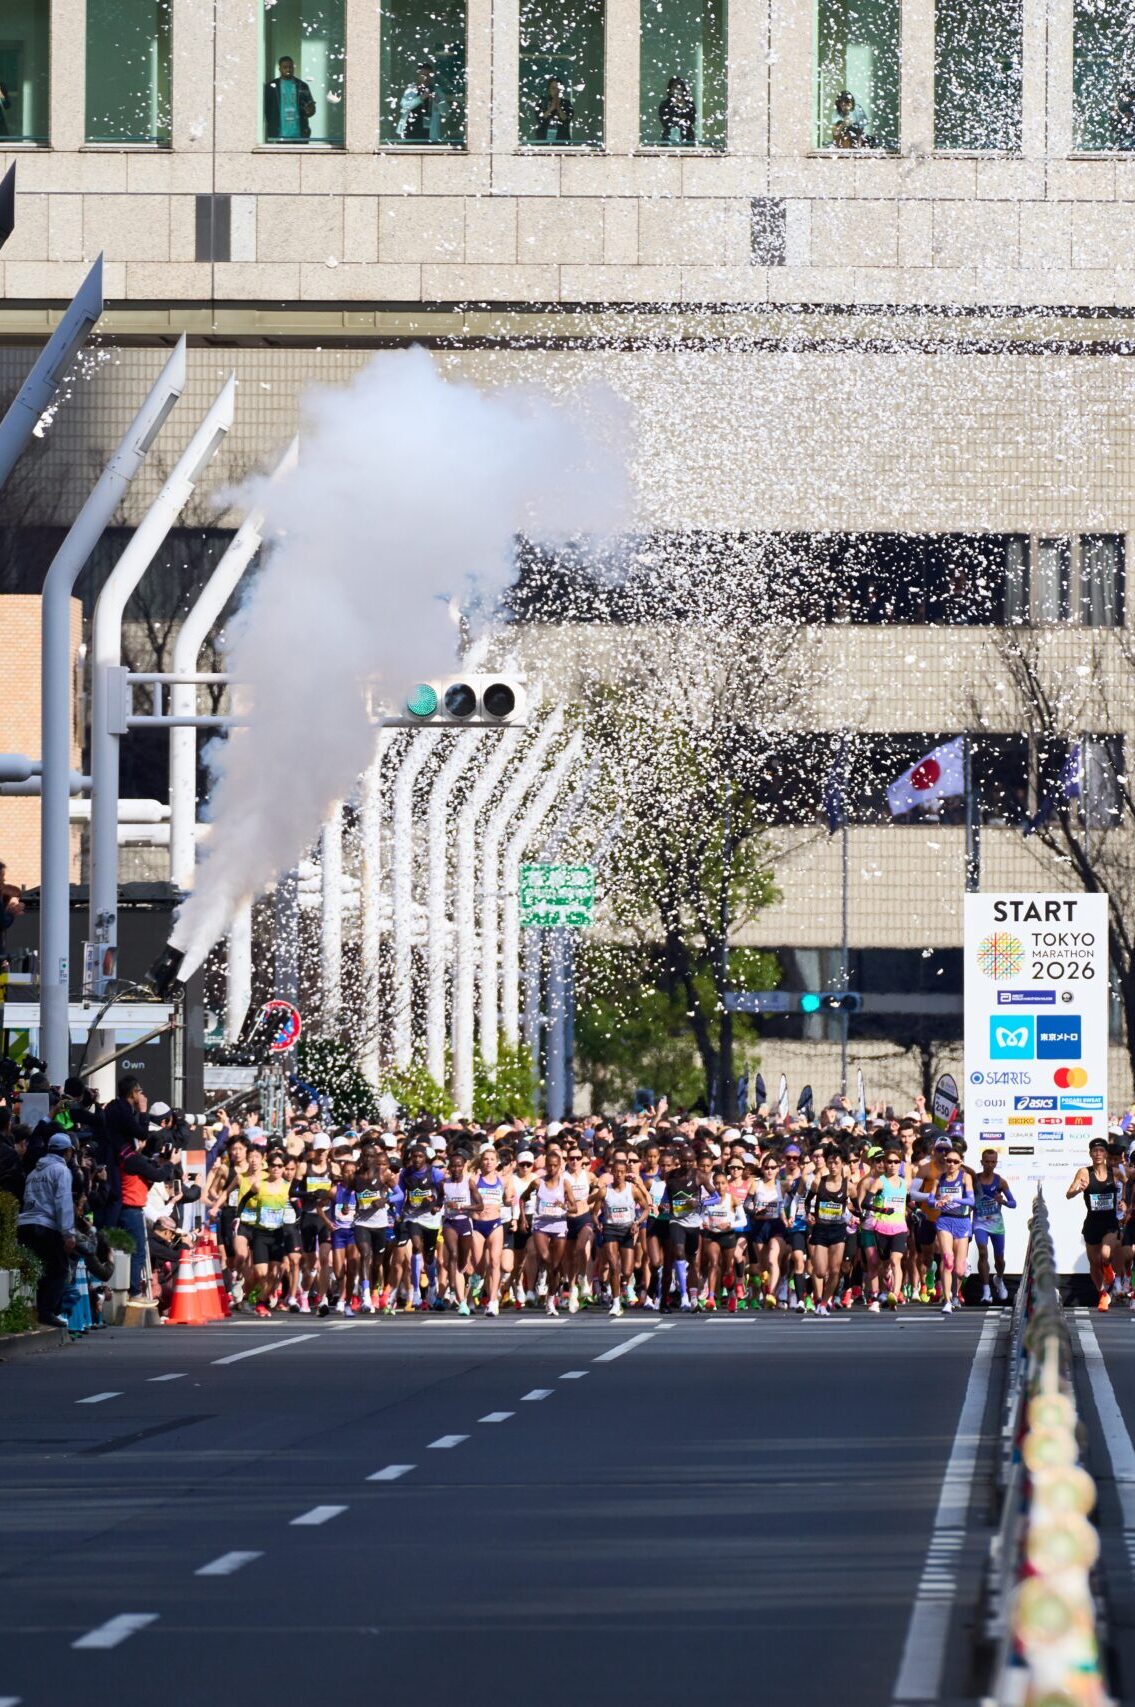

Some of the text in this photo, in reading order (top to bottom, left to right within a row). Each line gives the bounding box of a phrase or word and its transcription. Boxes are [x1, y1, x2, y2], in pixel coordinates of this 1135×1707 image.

[994, 901, 1077, 922] START
[1032, 933, 1095, 947] TOKYO
[1032, 950, 1094, 958] MARATHON
[1032, 961, 1095, 980] 2026
[1040, 1033, 1078, 1041] 東京メトロ
[121, 1059, 145, 1069] Own
[935, 1101, 949, 1117] 2:50
[1029, 1099, 1053, 1108] asics
